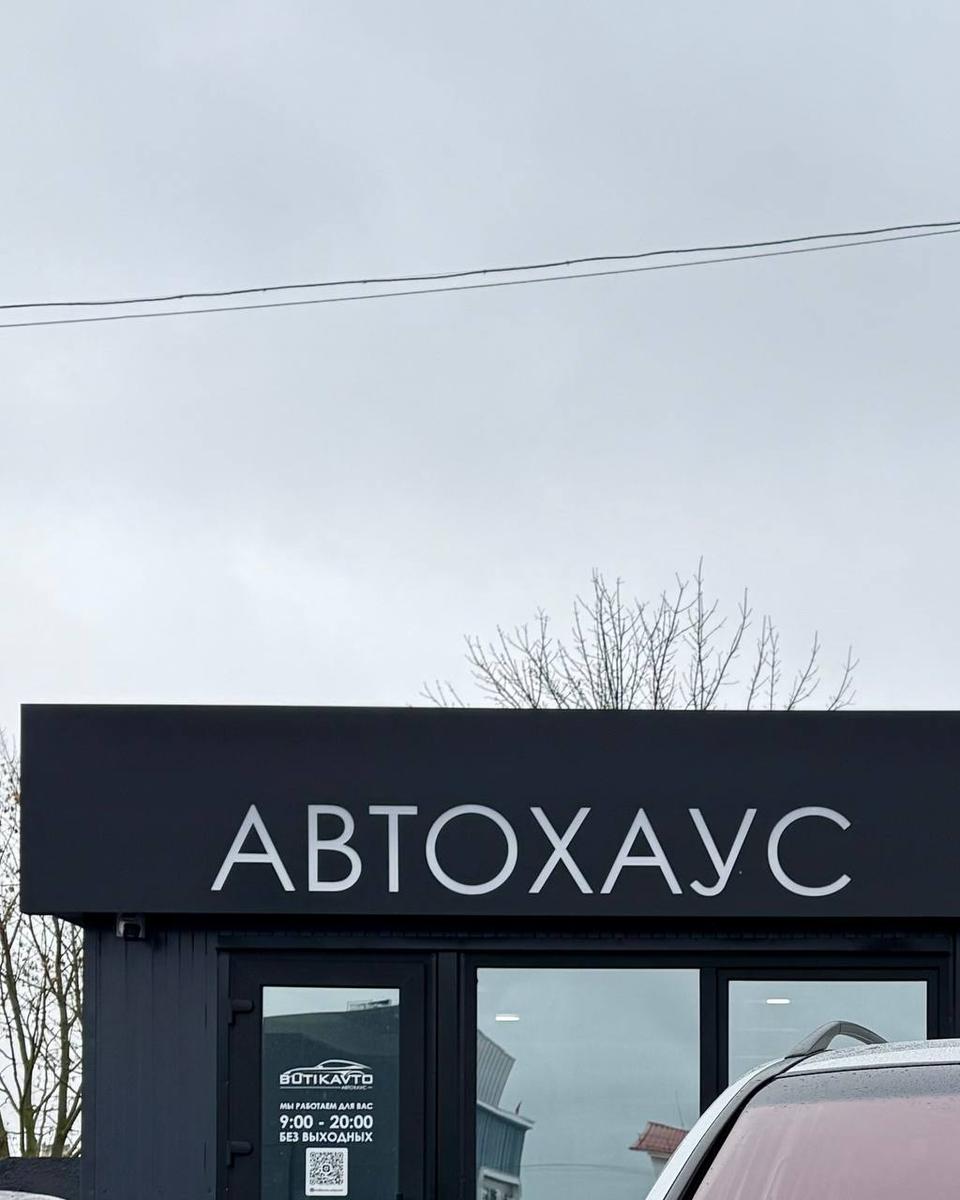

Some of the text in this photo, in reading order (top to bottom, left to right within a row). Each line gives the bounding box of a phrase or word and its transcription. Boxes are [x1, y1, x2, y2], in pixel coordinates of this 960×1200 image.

[211, 804, 853, 897] АВТОХАУС
[279, 1074, 373, 1085] BUTIKAVTO
[279, 1102, 374, 1111] МЫ РАБОТАЕМ ДЛЯ ВАС
[279, 1114, 314, 1129] 9:00
[329, 1114, 374, 1129] 20:00
[279, 1131, 373, 1143] БЕЗ ВЫХОДНЫХ
